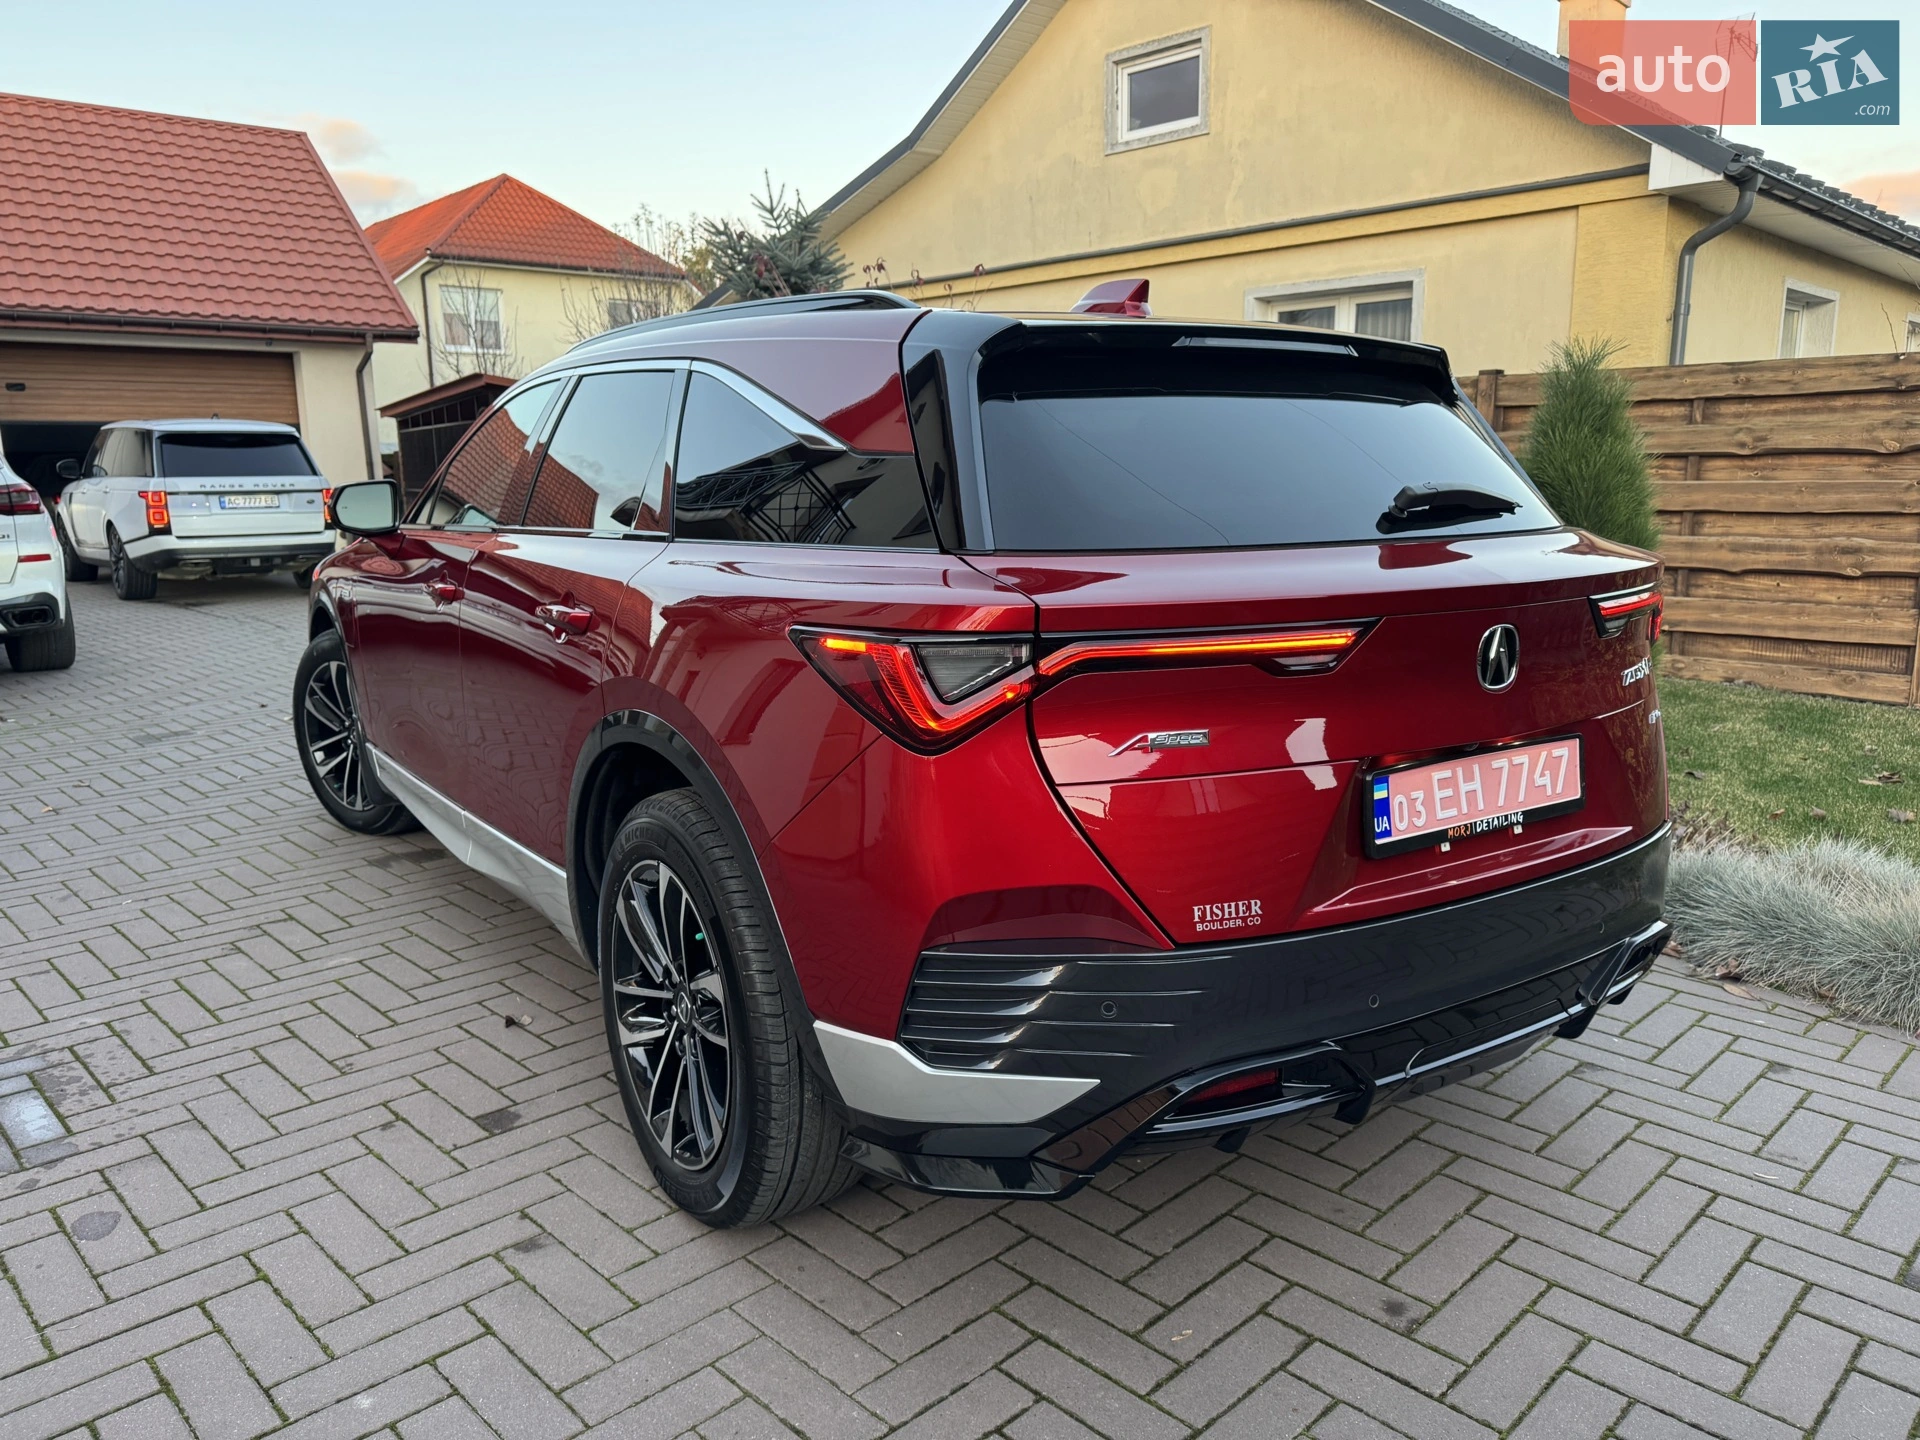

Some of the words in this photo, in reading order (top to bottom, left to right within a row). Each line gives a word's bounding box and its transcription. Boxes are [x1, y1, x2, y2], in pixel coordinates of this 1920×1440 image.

[1393, 790, 1427, 832] 03
[1431, 763, 1485, 821] EH
[1491, 747, 1569, 808] 7747
[1374, 815, 1391, 834] UA
[1192, 899, 1263, 922] FISHER
[1196, 919, 1245, 932] BOULDER,
[1247, 916, 1261, 926] CO
